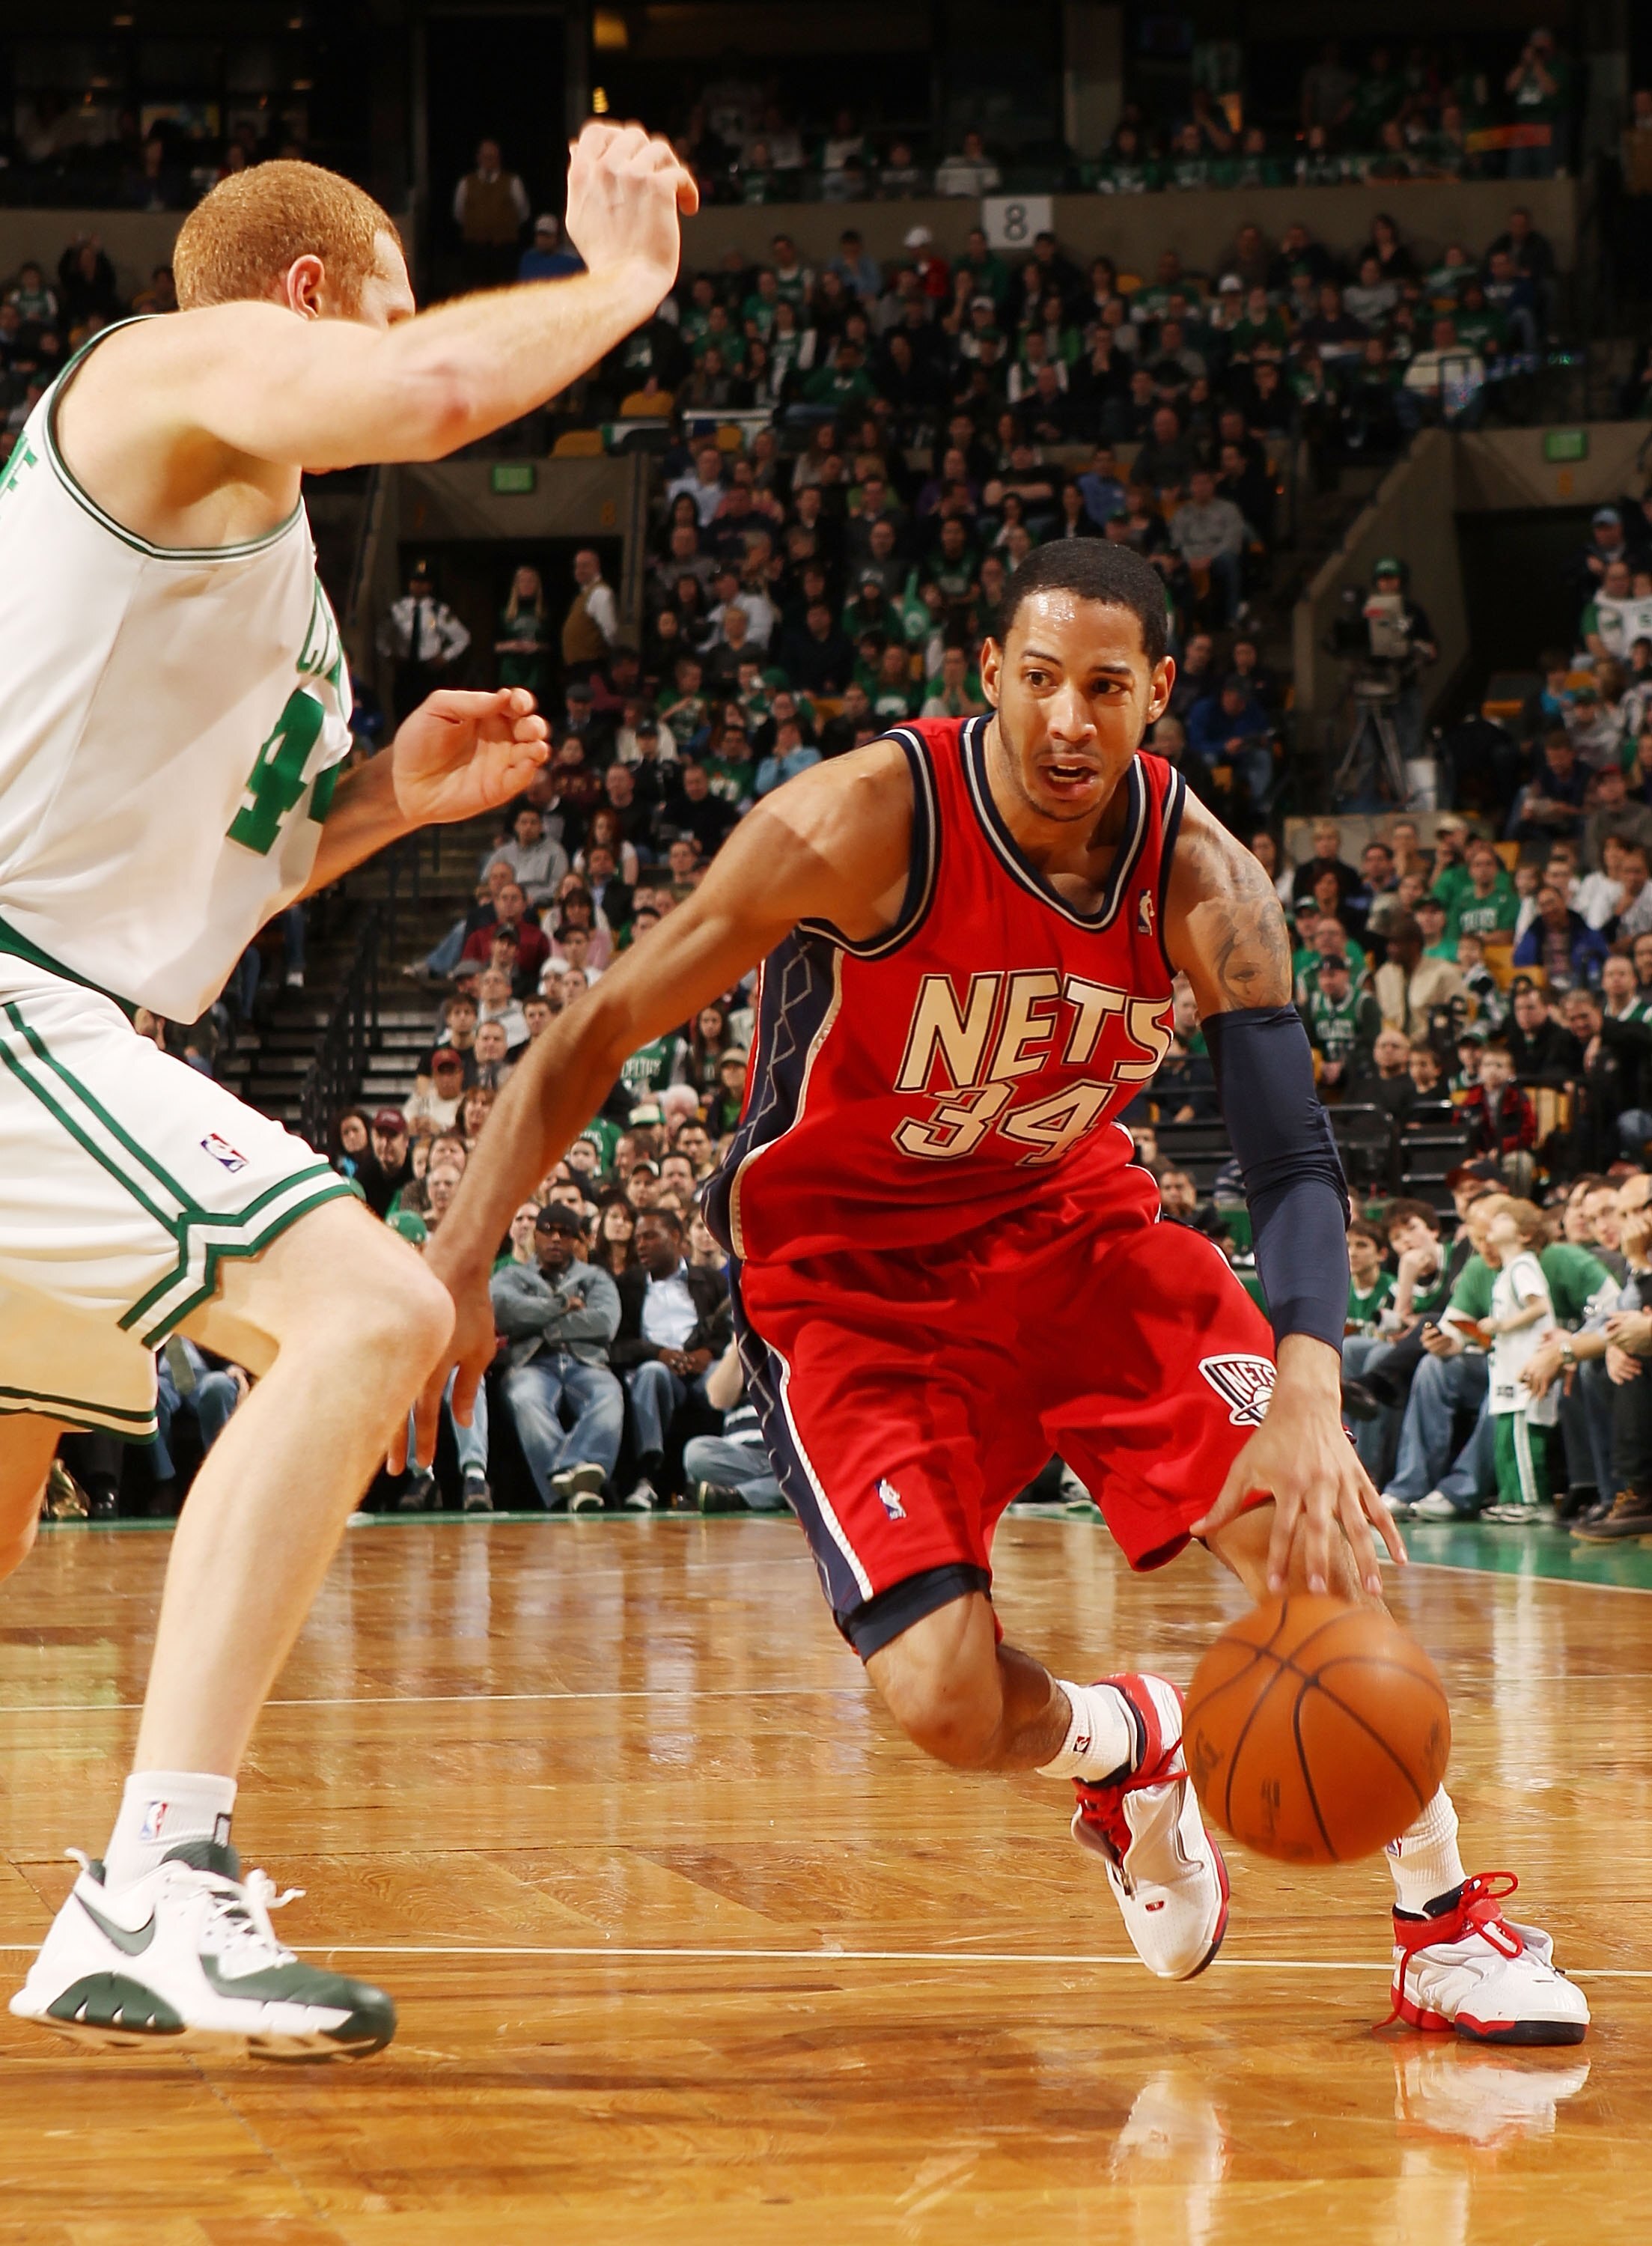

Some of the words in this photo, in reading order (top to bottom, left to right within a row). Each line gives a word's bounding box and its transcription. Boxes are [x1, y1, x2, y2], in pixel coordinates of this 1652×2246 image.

[1005, 203, 1028, 240] 8
[894, 969, 1174, 1094] NETS
[891, 1079, 1118, 1167] 34
[1215, 1362, 1276, 1403] NETS
